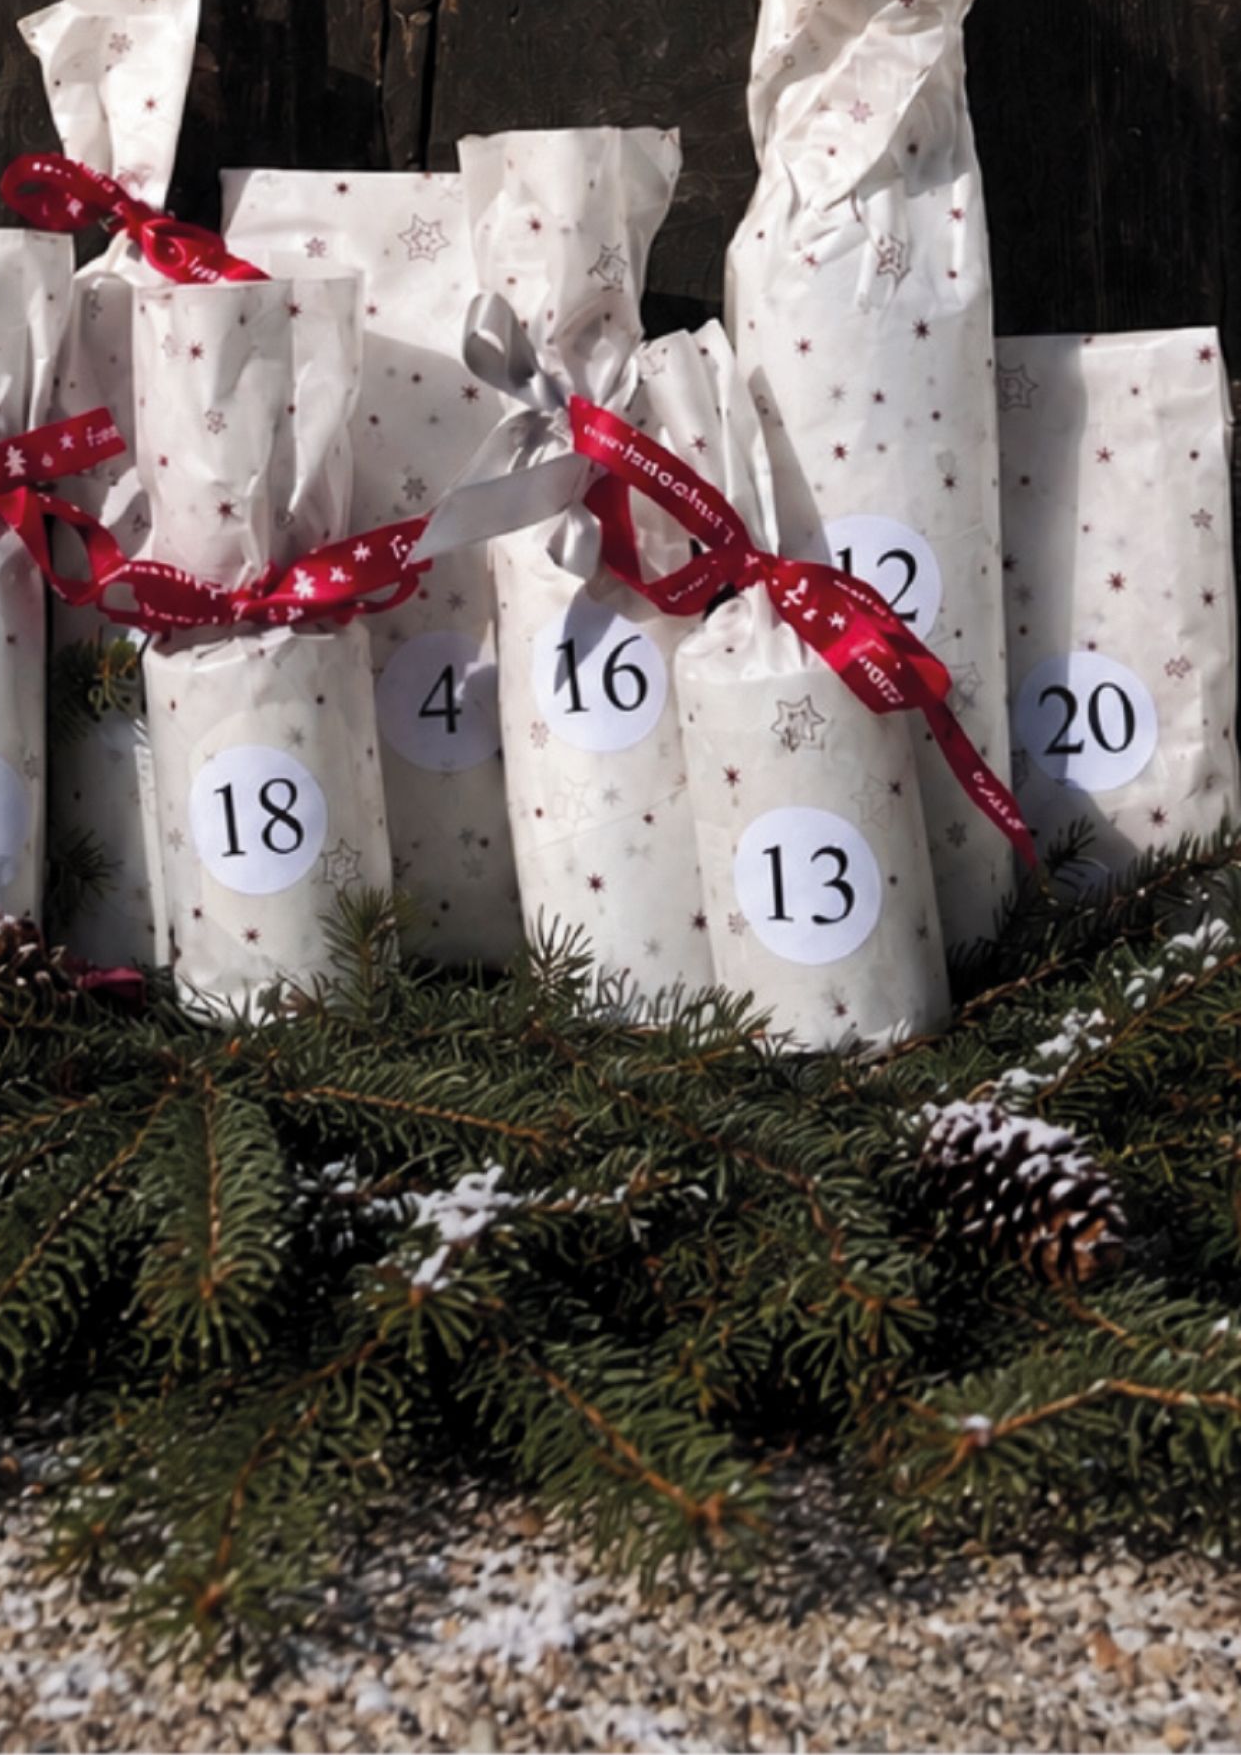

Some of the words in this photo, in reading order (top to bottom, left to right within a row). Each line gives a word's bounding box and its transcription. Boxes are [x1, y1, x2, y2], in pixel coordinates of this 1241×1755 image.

[418, 663, 462, 734] 4
[556, 634, 648, 713] 16
[1037, 681, 1137, 758] 20
[214, 778, 305, 856] 18
[760, 845, 856, 924] 13
